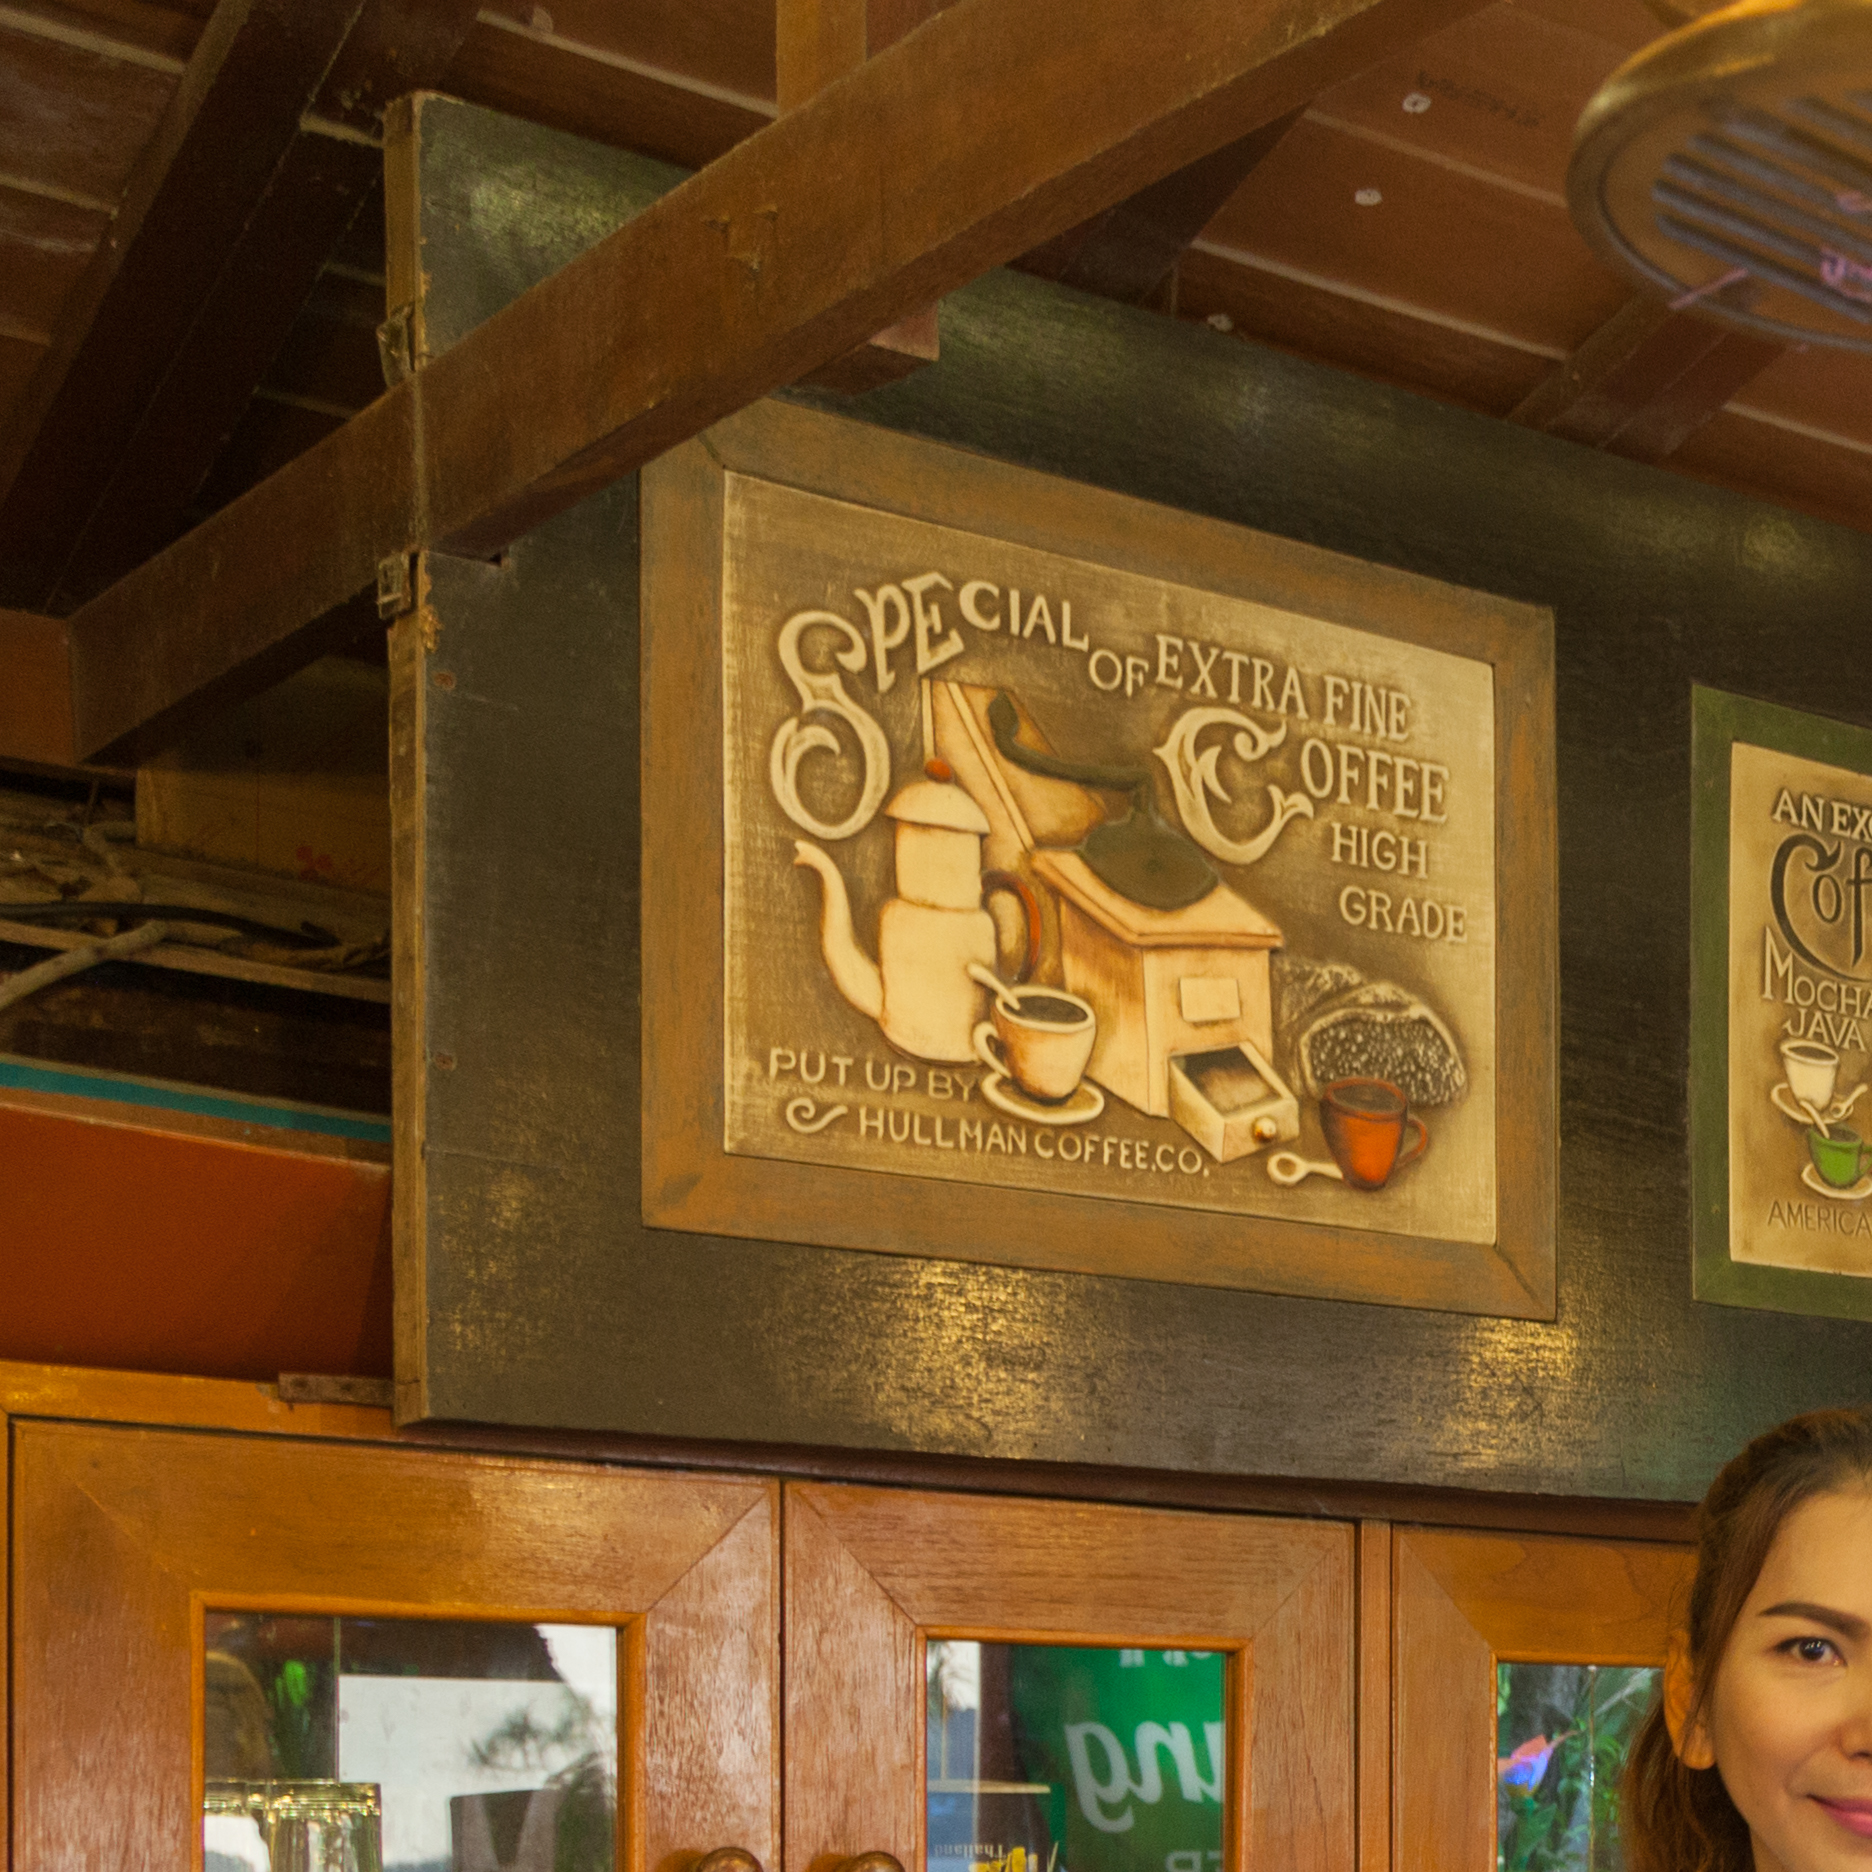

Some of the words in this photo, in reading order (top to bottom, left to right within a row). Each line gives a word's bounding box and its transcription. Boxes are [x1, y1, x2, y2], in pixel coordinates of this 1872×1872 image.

[769, 570, 1089, 841] SPECIAL
[1087, 648, 1150, 698] OF
[1154, 633, 1308, 720] EXTRA
[1322, 673, 1412, 745] FINE
[1153, 706, 1451, 865] COFFEE
[1770, 788, 1825, 831] AN
[1329, 821, 1430, 880] HIGH
[1338, 888, 1468, 945] GRADE
[1782, 1007, 1869, 1053] JAVA
[768, 1047, 855, 1087] PUT
[865, 1056, 918, 1094] UP
[928, 1067, 981, 1102] BY
[858, 1106, 1028, 1156] HULLMAN
